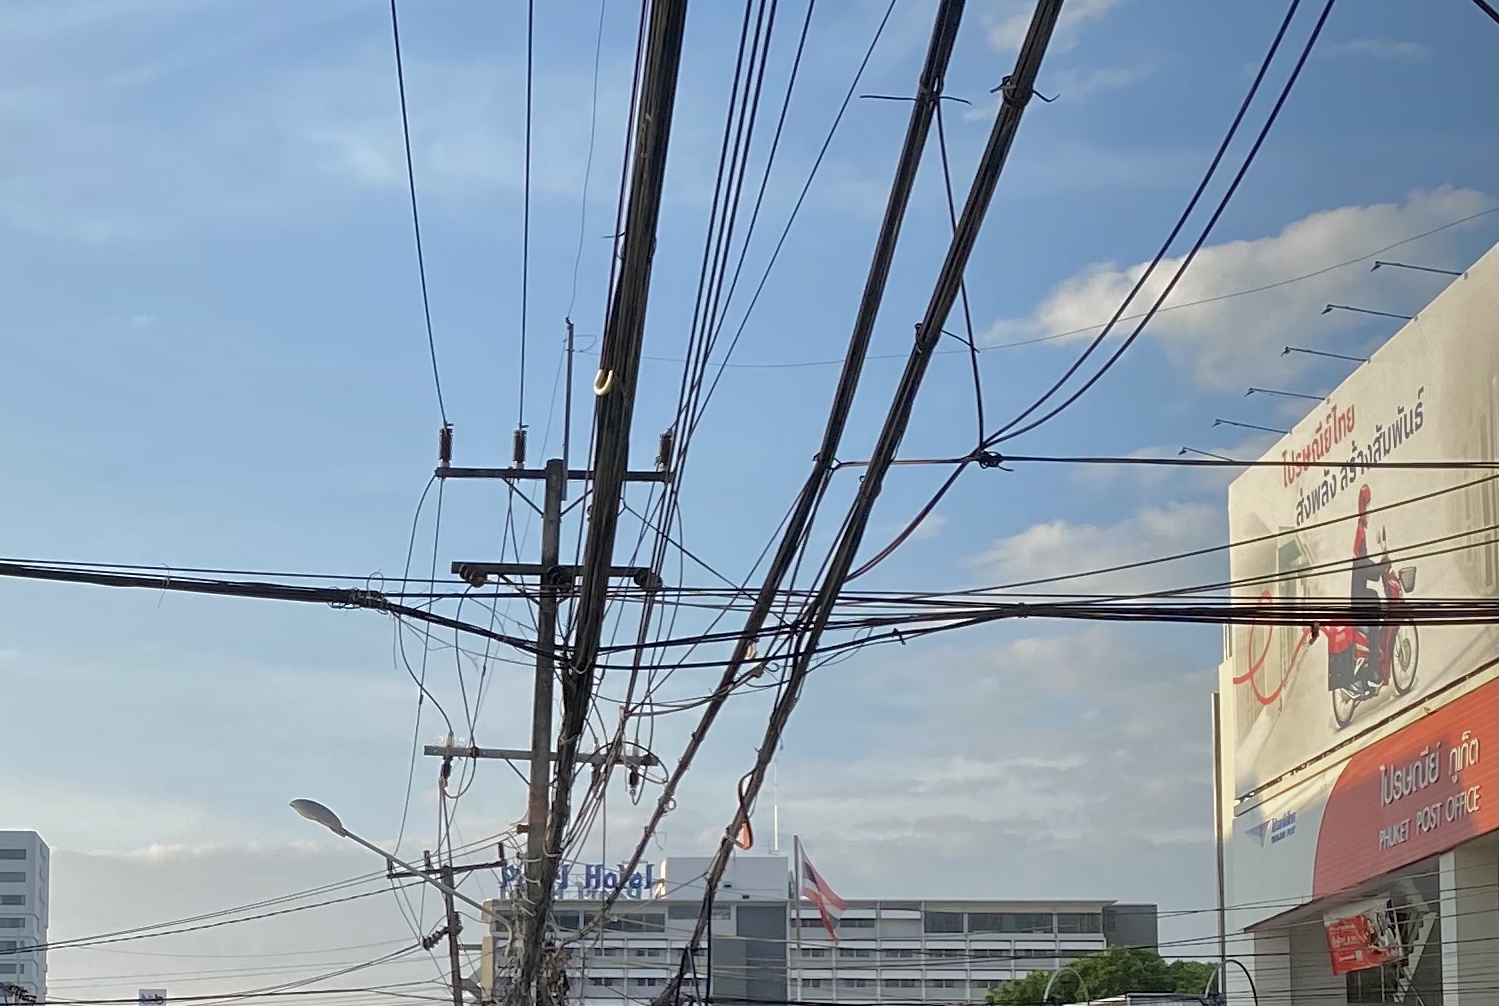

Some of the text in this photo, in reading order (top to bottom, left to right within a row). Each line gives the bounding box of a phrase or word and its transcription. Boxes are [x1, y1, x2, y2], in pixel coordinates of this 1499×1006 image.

[1380, 730, 1479, 807] ไปรษณีย์ ภูเก็ต
[1379, 785, 1481, 851] PHUKET POST OFFICE
